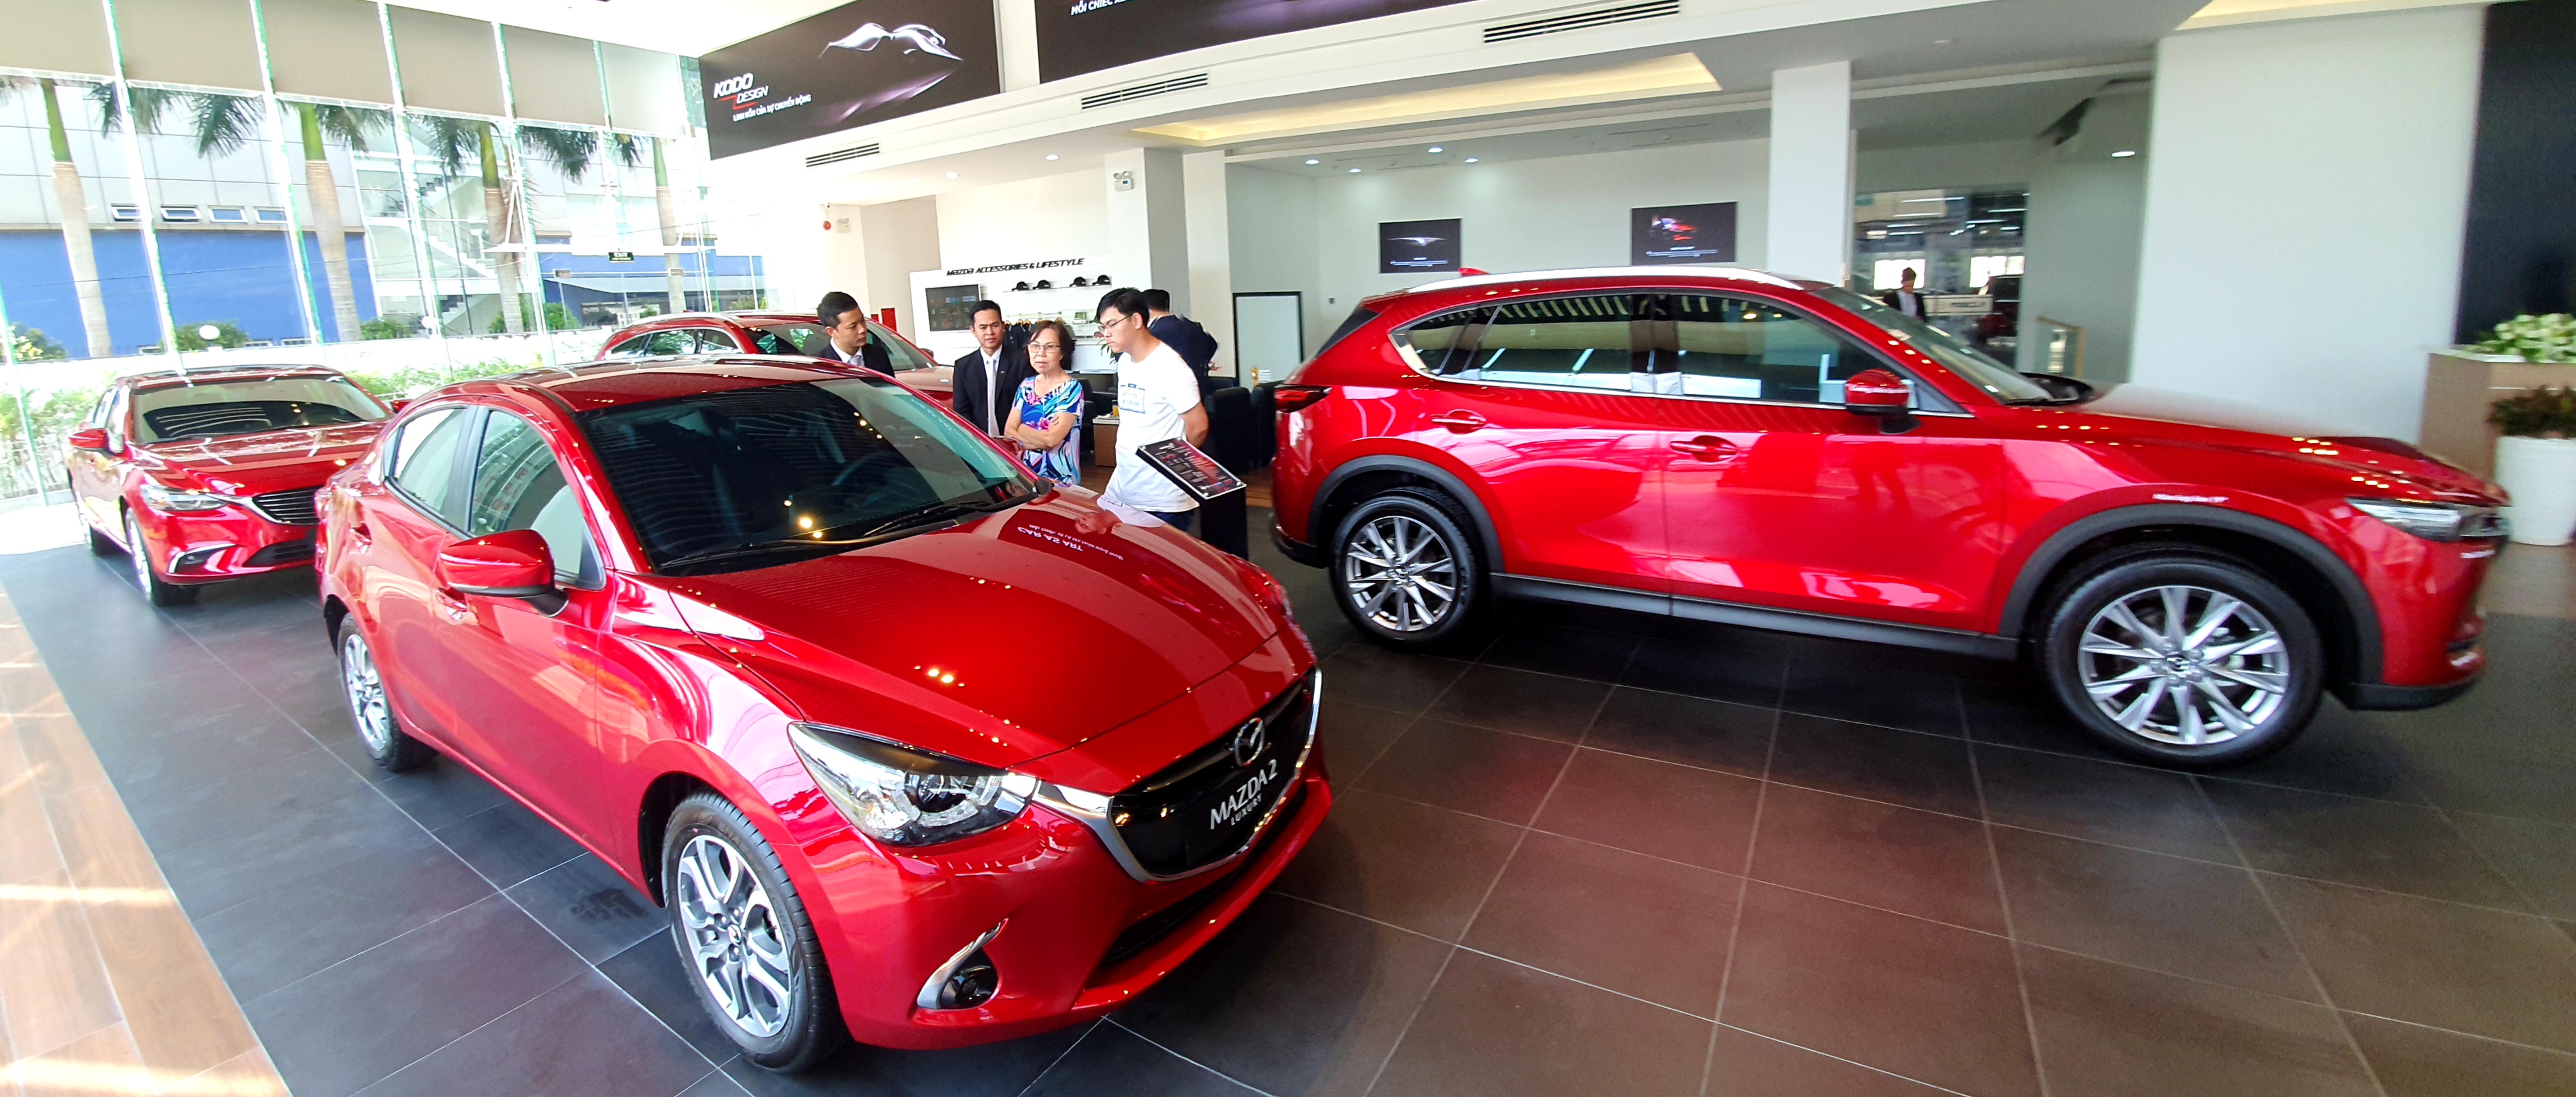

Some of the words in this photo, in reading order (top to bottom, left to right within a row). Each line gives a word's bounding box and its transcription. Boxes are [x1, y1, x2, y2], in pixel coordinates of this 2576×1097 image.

[714, 72, 754, 99] KODO
[736, 86, 769, 104] DESIGN
[975, 263, 1029, 274] ACCESSORIES
[1036, 258, 1084, 268] LIFESTYLE
[1210, 769, 1268, 829] MAZDA
